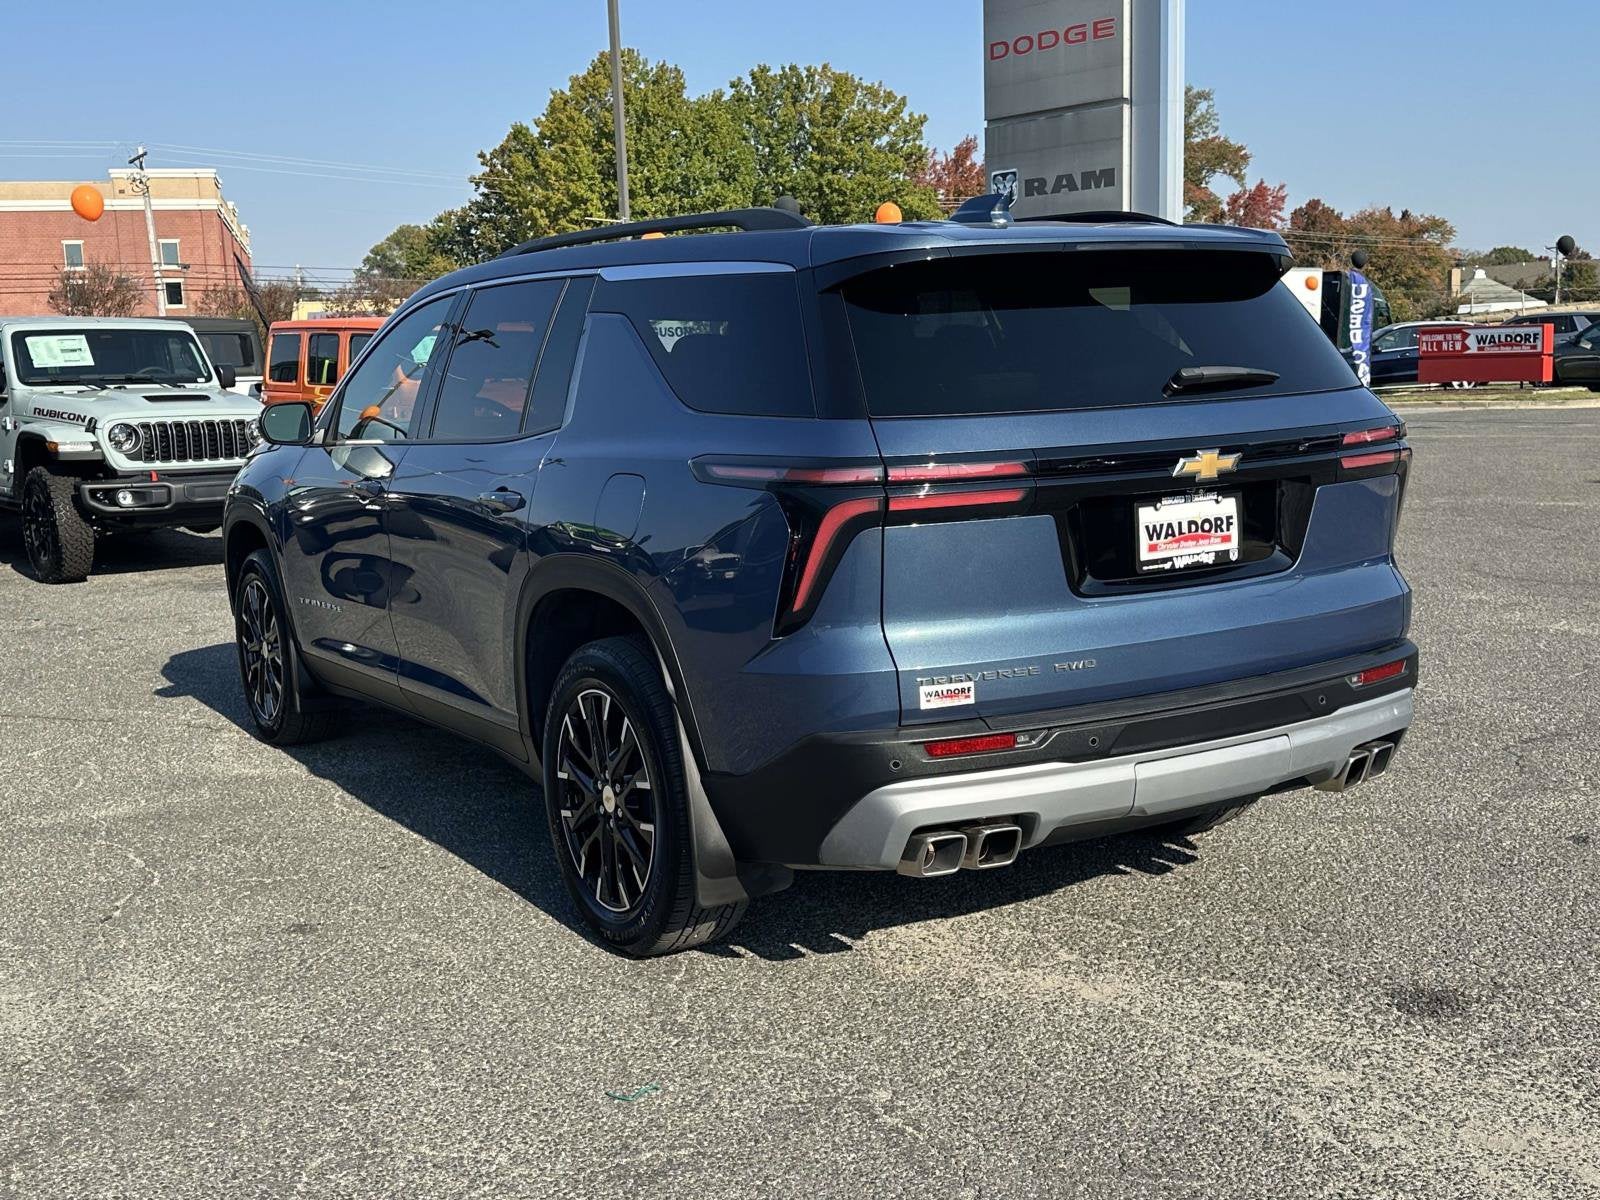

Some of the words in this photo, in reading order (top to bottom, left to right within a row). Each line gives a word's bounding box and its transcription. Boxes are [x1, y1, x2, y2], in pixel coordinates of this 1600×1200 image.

[989, 17, 1116, 61] DODGE
[1023, 167, 1116, 197] RAM
[1422, 341, 1438, 352] ALL
[1442, 340, 1462, 351] NEW
[1475, 332, 1540, 346] WALDORF
[33, 407, 87, 424] RUBICON
[1145, 516, 1233, 541] WALDORF
[299, 597, 343, 613] TRAVERSE
[916, 665, 1041, 686] TRAVERSE
[924, 687, 971, 699] WALDORF
